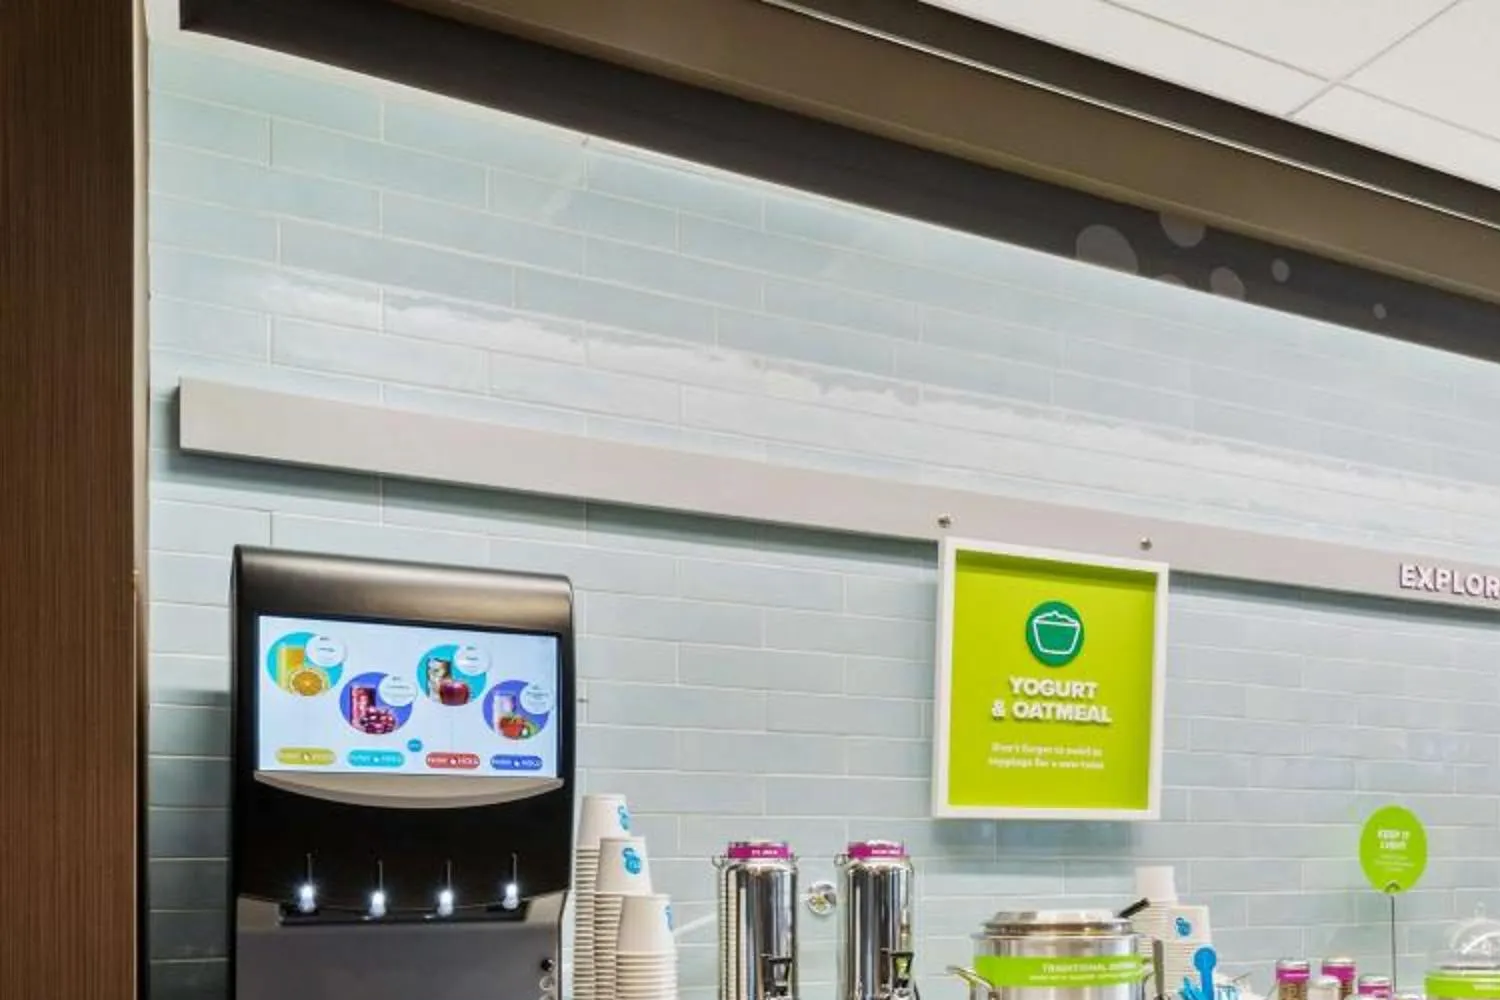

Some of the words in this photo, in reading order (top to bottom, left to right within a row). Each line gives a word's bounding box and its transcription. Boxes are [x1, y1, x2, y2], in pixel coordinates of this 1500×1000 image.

[1009, 675, 1098, 699] YOGURT
[992, 699, 1006, 719] &
[1012, 700, 1112, 724] OATMEAL
